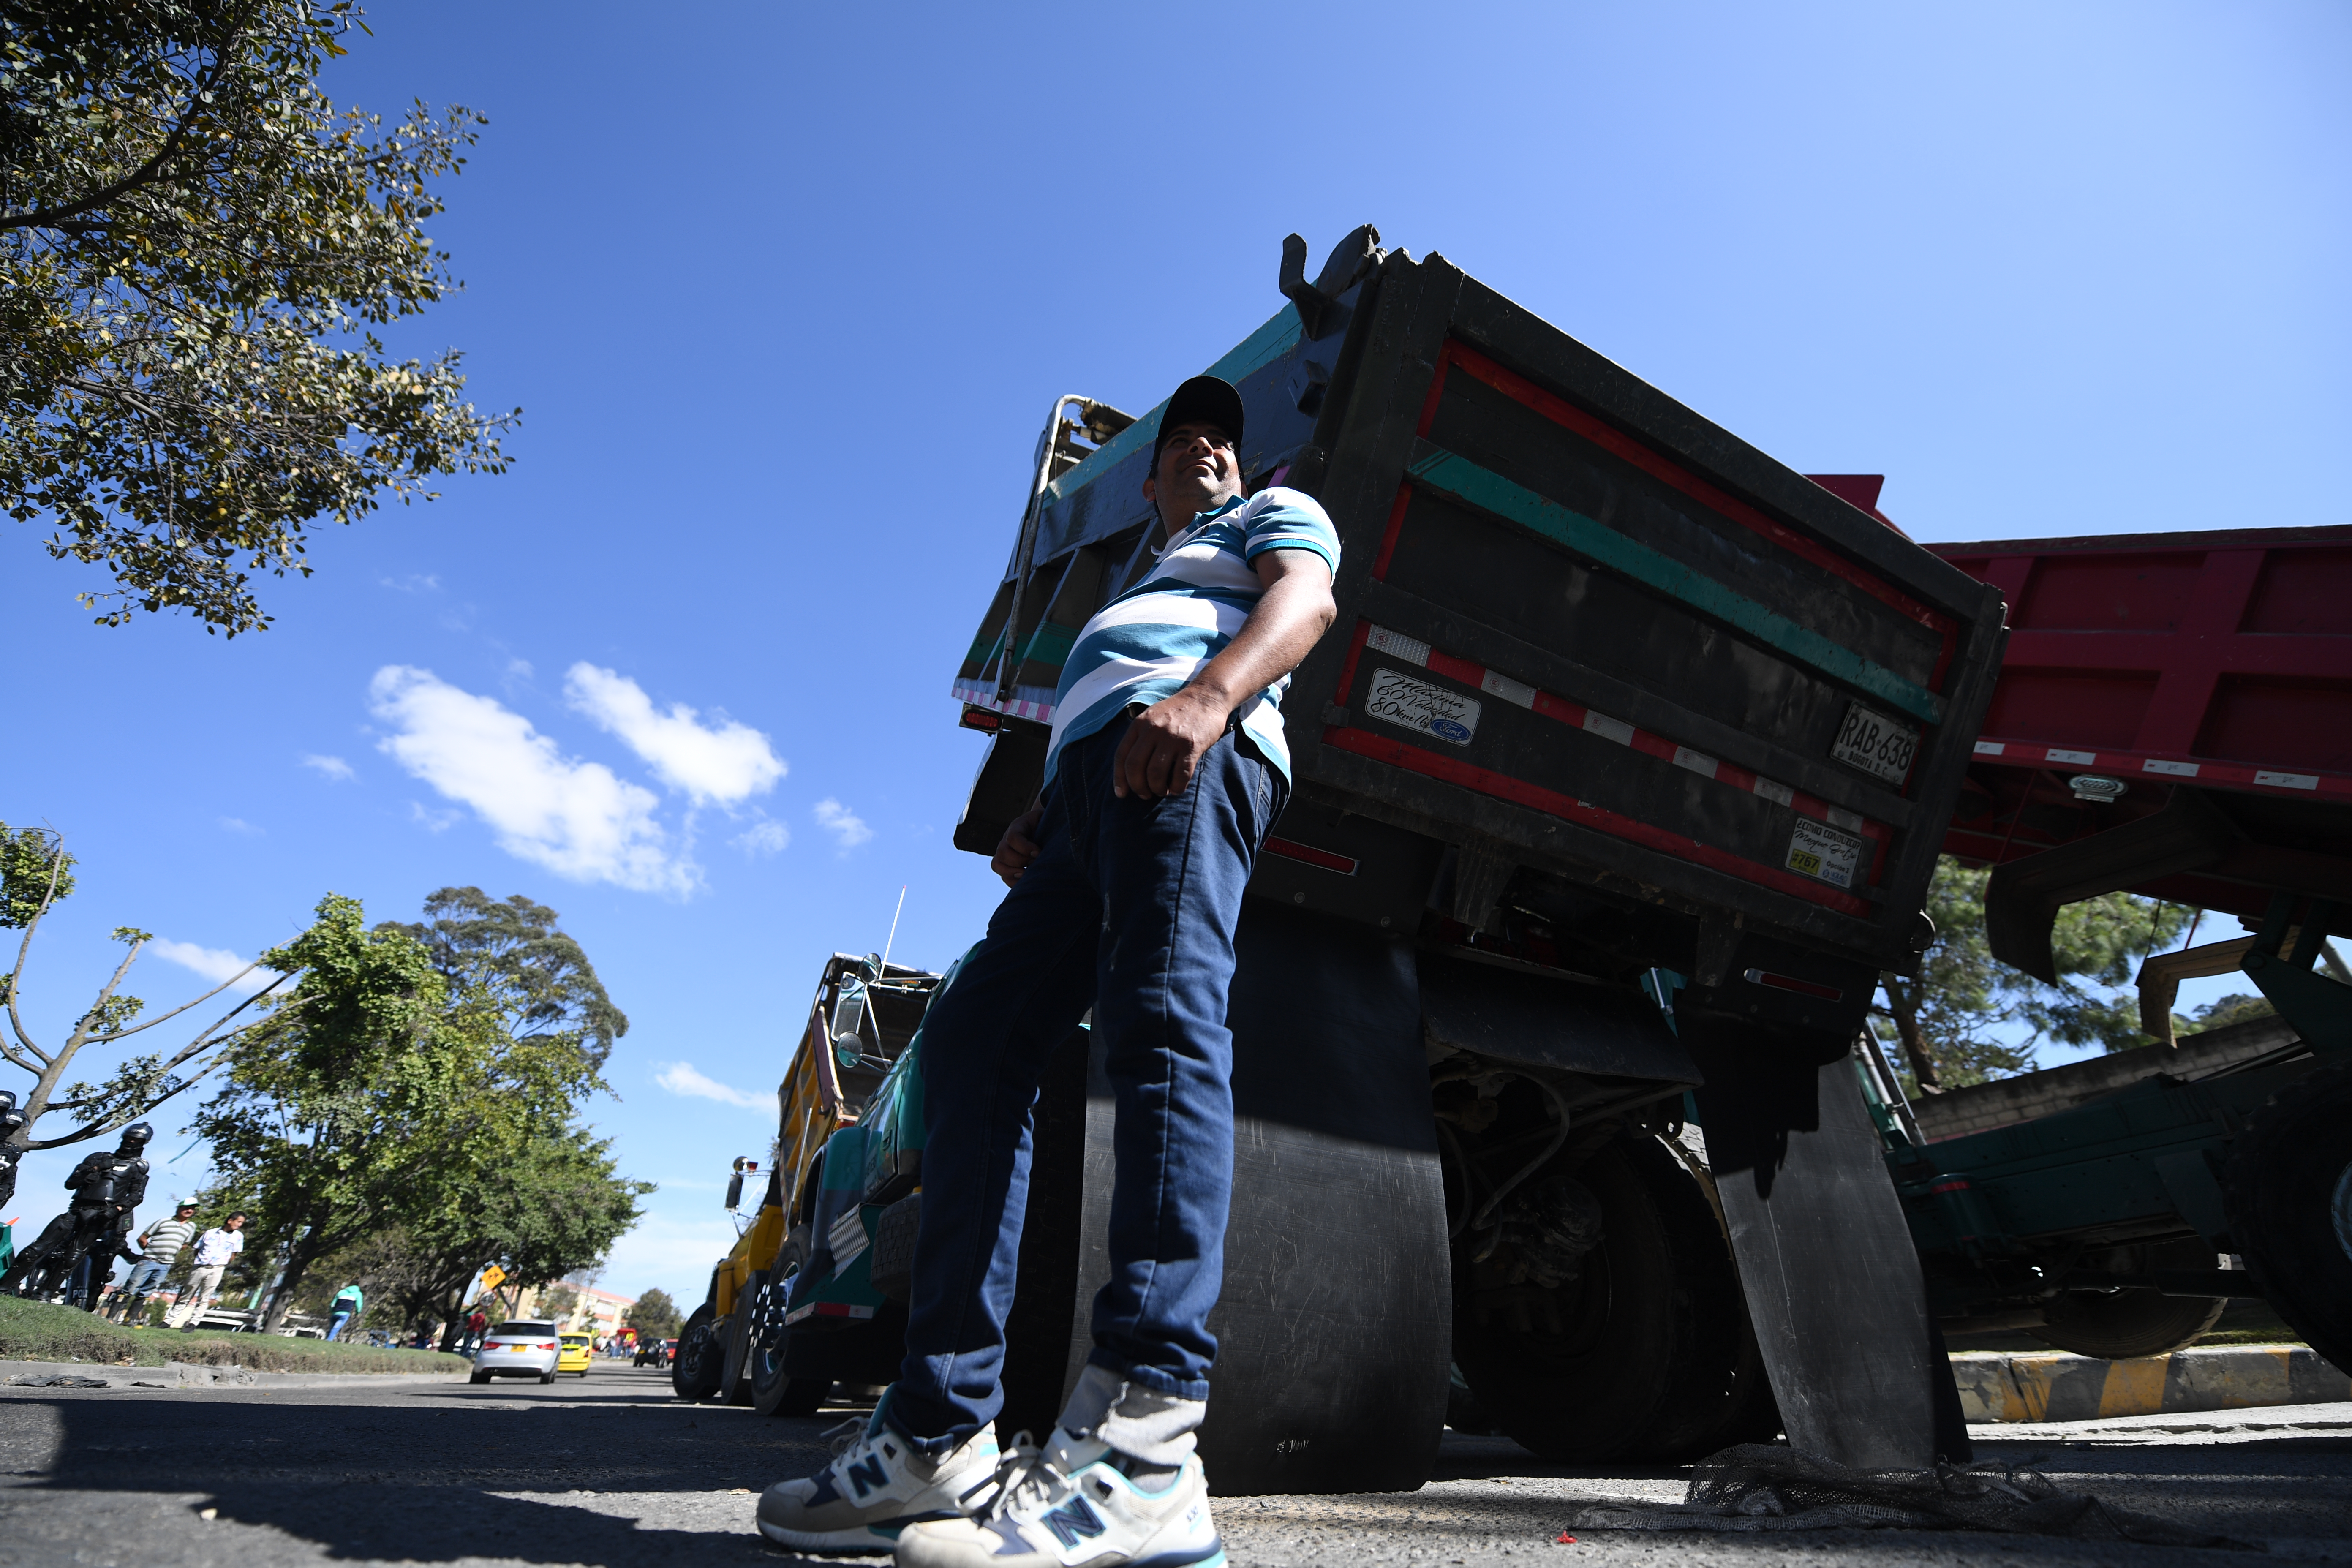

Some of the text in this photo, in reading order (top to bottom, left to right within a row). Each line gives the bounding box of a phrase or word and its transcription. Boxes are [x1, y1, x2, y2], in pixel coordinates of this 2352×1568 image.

[1439, 723, 1463, 737] Ford
[1794, 830, 1828, 853] Marque
[1797, 820, 1861, 849] ¿COMO CONDUZCO?
[1792, 853, 1819, 868] #767
[1827, 860, 1846, 872] Opción
[847, 1452, 890, 1499] N
[1040, 1493, 1107, 1551] N
